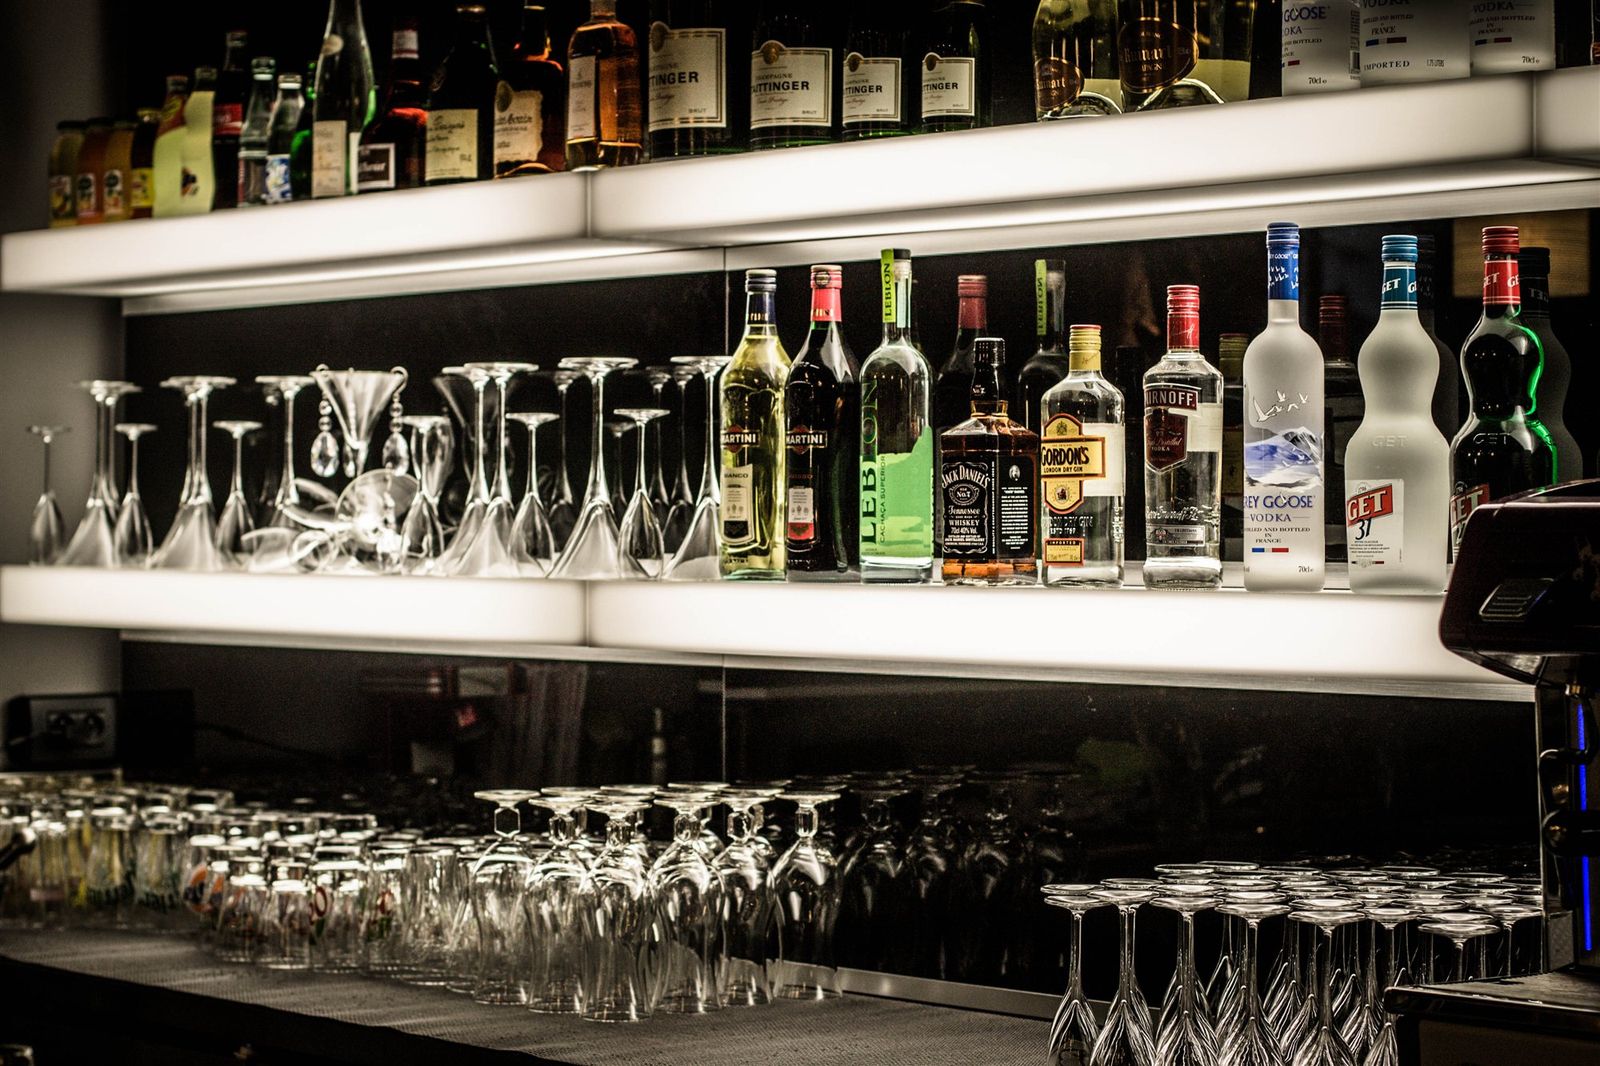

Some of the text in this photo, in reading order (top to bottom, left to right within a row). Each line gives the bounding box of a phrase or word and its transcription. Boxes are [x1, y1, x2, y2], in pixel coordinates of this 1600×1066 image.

[1284, 6, 1327, 22] GOOSE
[1363, 60, 1411, 71] IMPORTED
[883, 262, 892, 317] LEBLON
[861, 379, 878, 545] LEBLON
[1041, 445, 1090, 467] GORDON'S
[942, 464, 991, 489] JACK DANIEL'S
[1074, 465, 1083, 473] GIN
[948, 505, 981, 515] Tennessee
[1262, 495, 1314, 509] GOOSE
[1347, 490, 1387, 521] GET
[948, 519, 980, 527] WHISKEY
[1249, 513, 1292, 523] VODKA
[1355, 519, 1372, 540] 31
